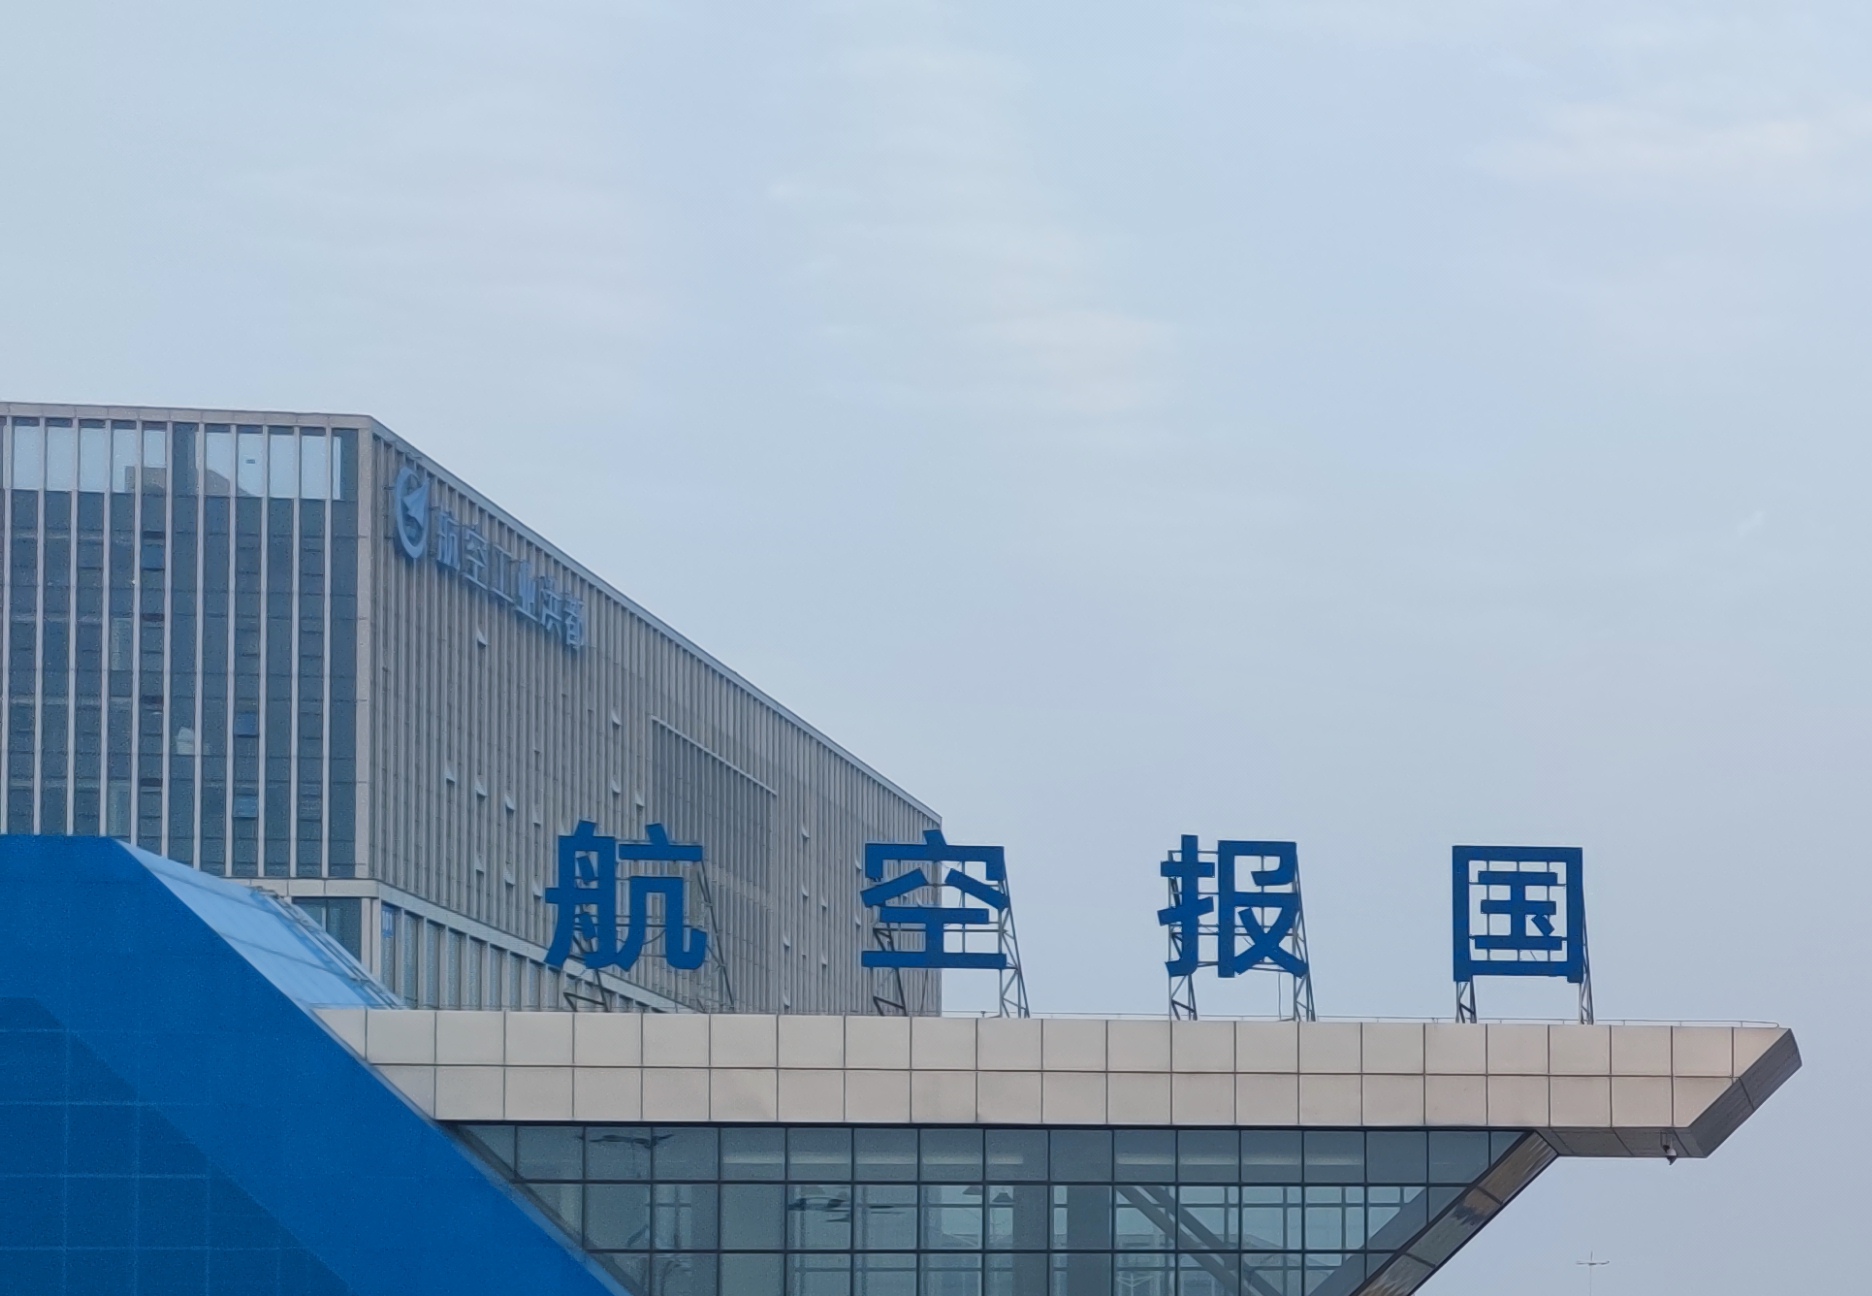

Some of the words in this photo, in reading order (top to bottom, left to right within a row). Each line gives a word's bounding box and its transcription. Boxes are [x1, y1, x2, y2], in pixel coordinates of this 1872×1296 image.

[435, 510, 584, 648] 航空工业洪都
[544, 820, 1586, 984] 航空报国
